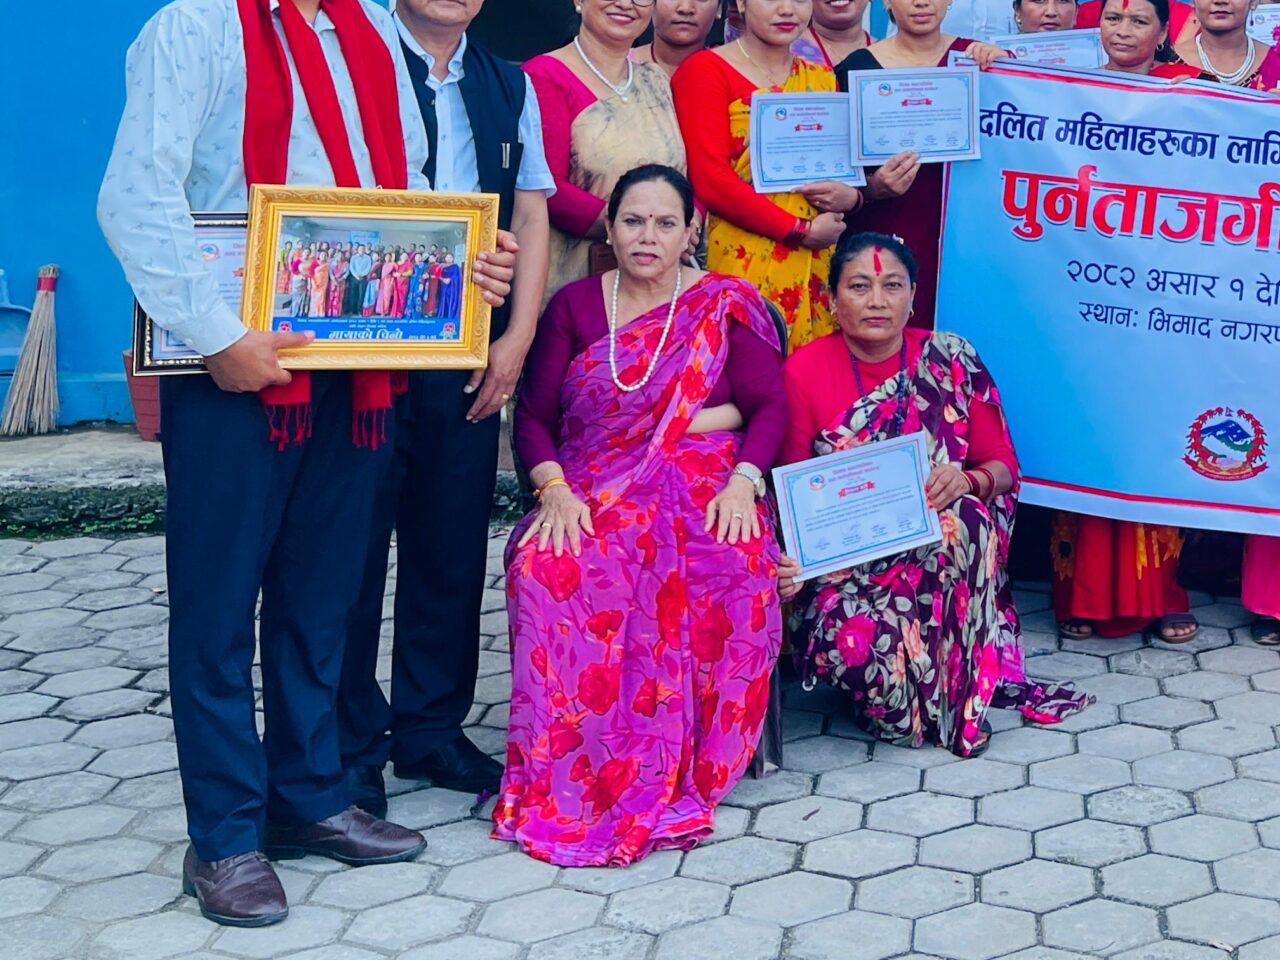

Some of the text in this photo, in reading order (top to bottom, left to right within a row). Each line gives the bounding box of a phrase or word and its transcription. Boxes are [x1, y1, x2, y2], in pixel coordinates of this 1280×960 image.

[980, 101, 1049, 141] दलित
[1067, 260, 1136, 288] २०८२
[1146, 268, 1220, 298] असार
[1229, 278, 1244, 301] १
[1148, 307, 1213, 339] भिमाद
